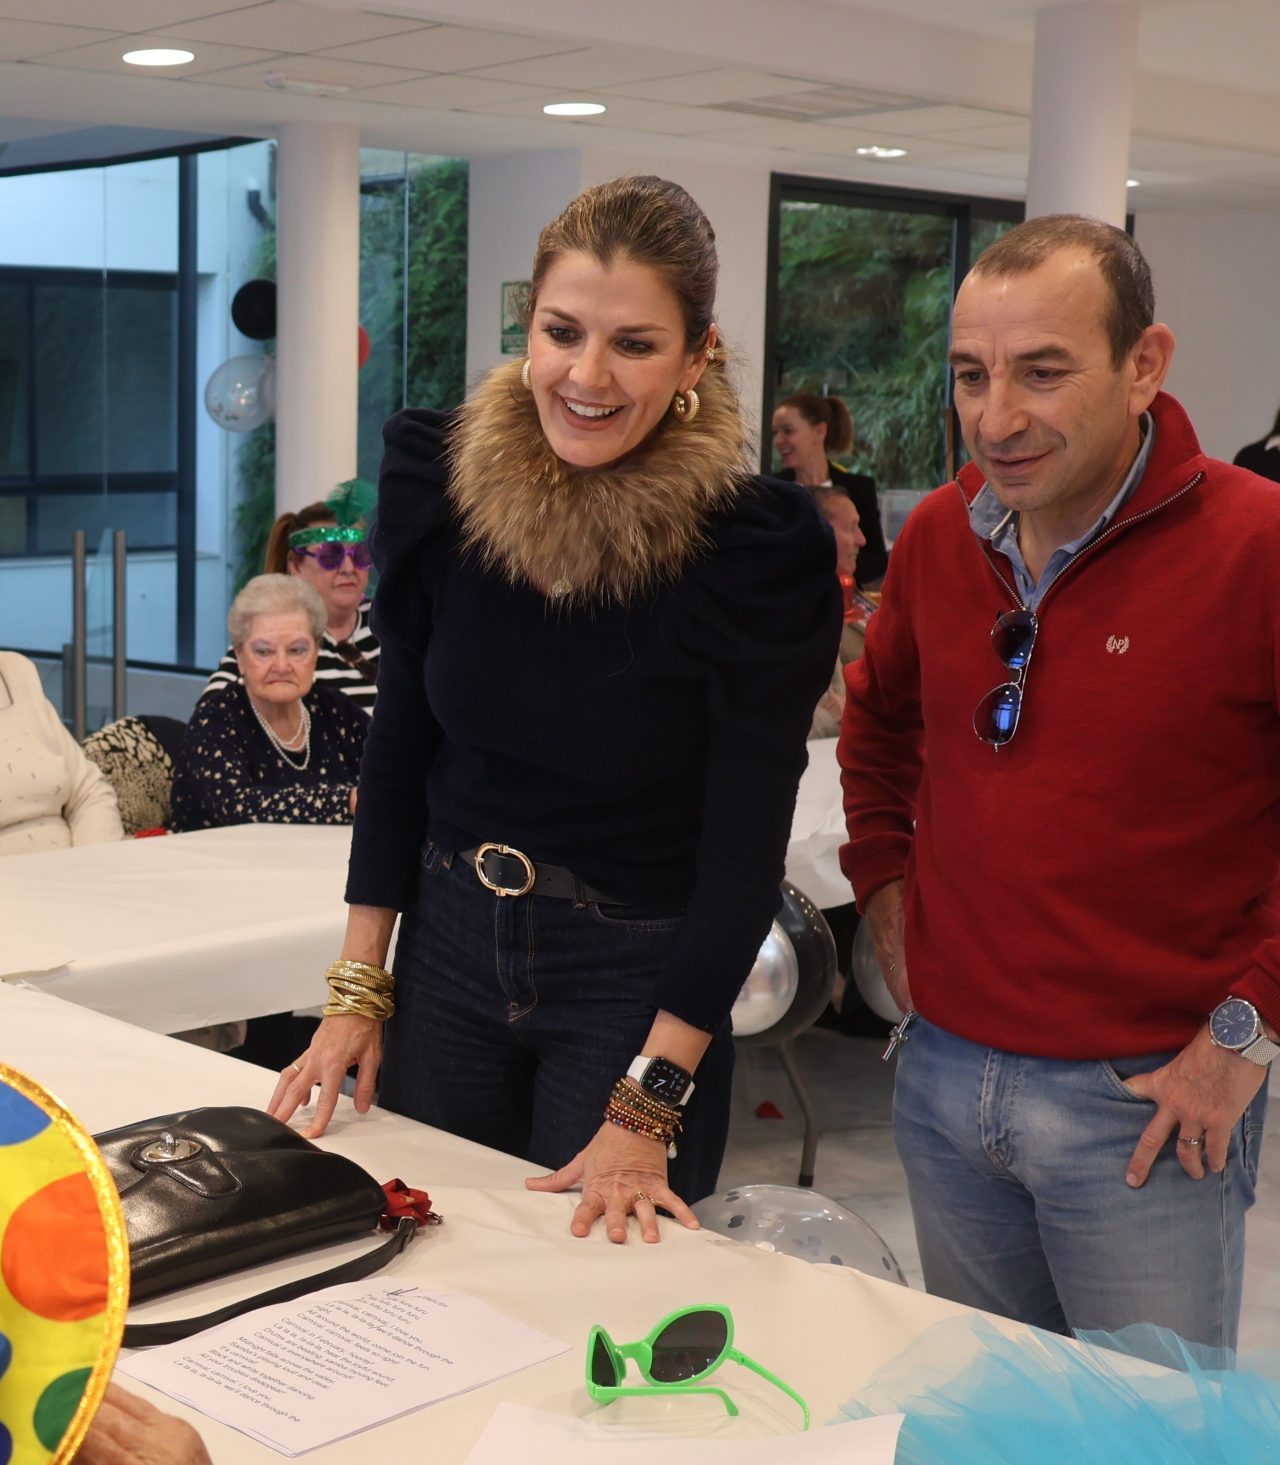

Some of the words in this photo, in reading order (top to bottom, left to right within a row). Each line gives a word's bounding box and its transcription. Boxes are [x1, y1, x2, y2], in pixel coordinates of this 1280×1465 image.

[316, 1314, 340, 1327] around
[238, 1336, 266, 1352] Midnight
[392, 1335, 414, 1347] dance
[413, 1345, 441, 1360] through
[257, 1355, 282, 1368] playing
[287, 1350, 326, 1368] everywhere
[324, 1359, 348, 1370] samba
[259, 1373, 288, 1386] together
[239, 1393, 261, 1404] dance
[261, 1403, 289, 1416] through
